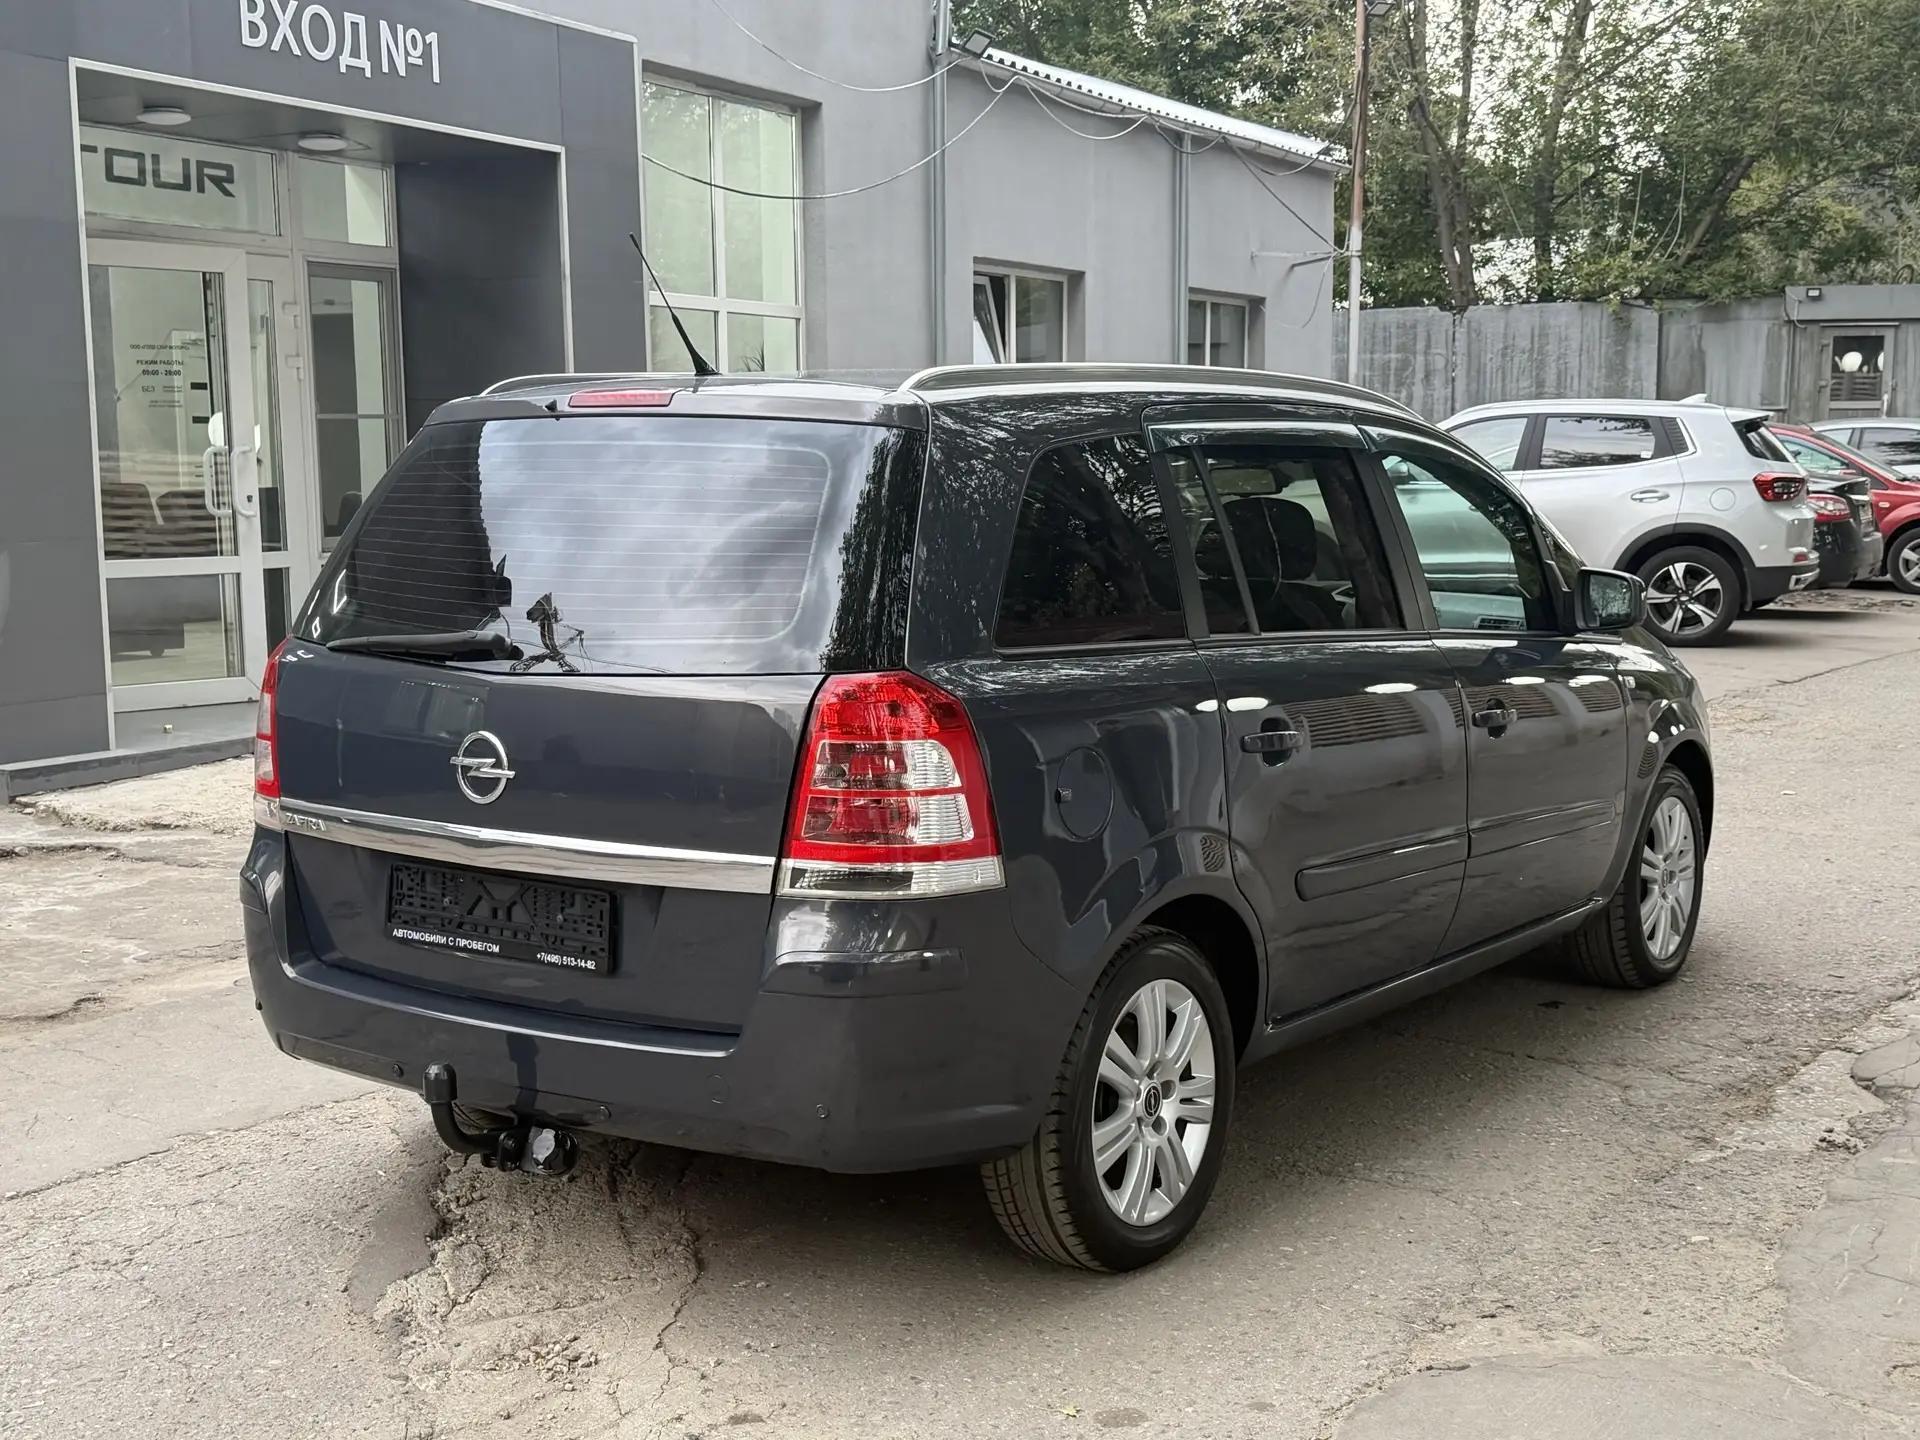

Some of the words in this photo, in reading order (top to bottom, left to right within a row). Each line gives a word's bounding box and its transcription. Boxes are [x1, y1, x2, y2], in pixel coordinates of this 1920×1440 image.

[239, 0, 372, 78] ВХОД
[379, 19, 440, 84] №1
[392, 928, 447, 945] АВТОМОБИЛИ
[448, 937, 455, 946] С
[455, 938, 500, 953] ПРОБЕГОМ
[536, 952, 561, 966] +7(495)
[562, 955, 597, 970] 513-14-82
